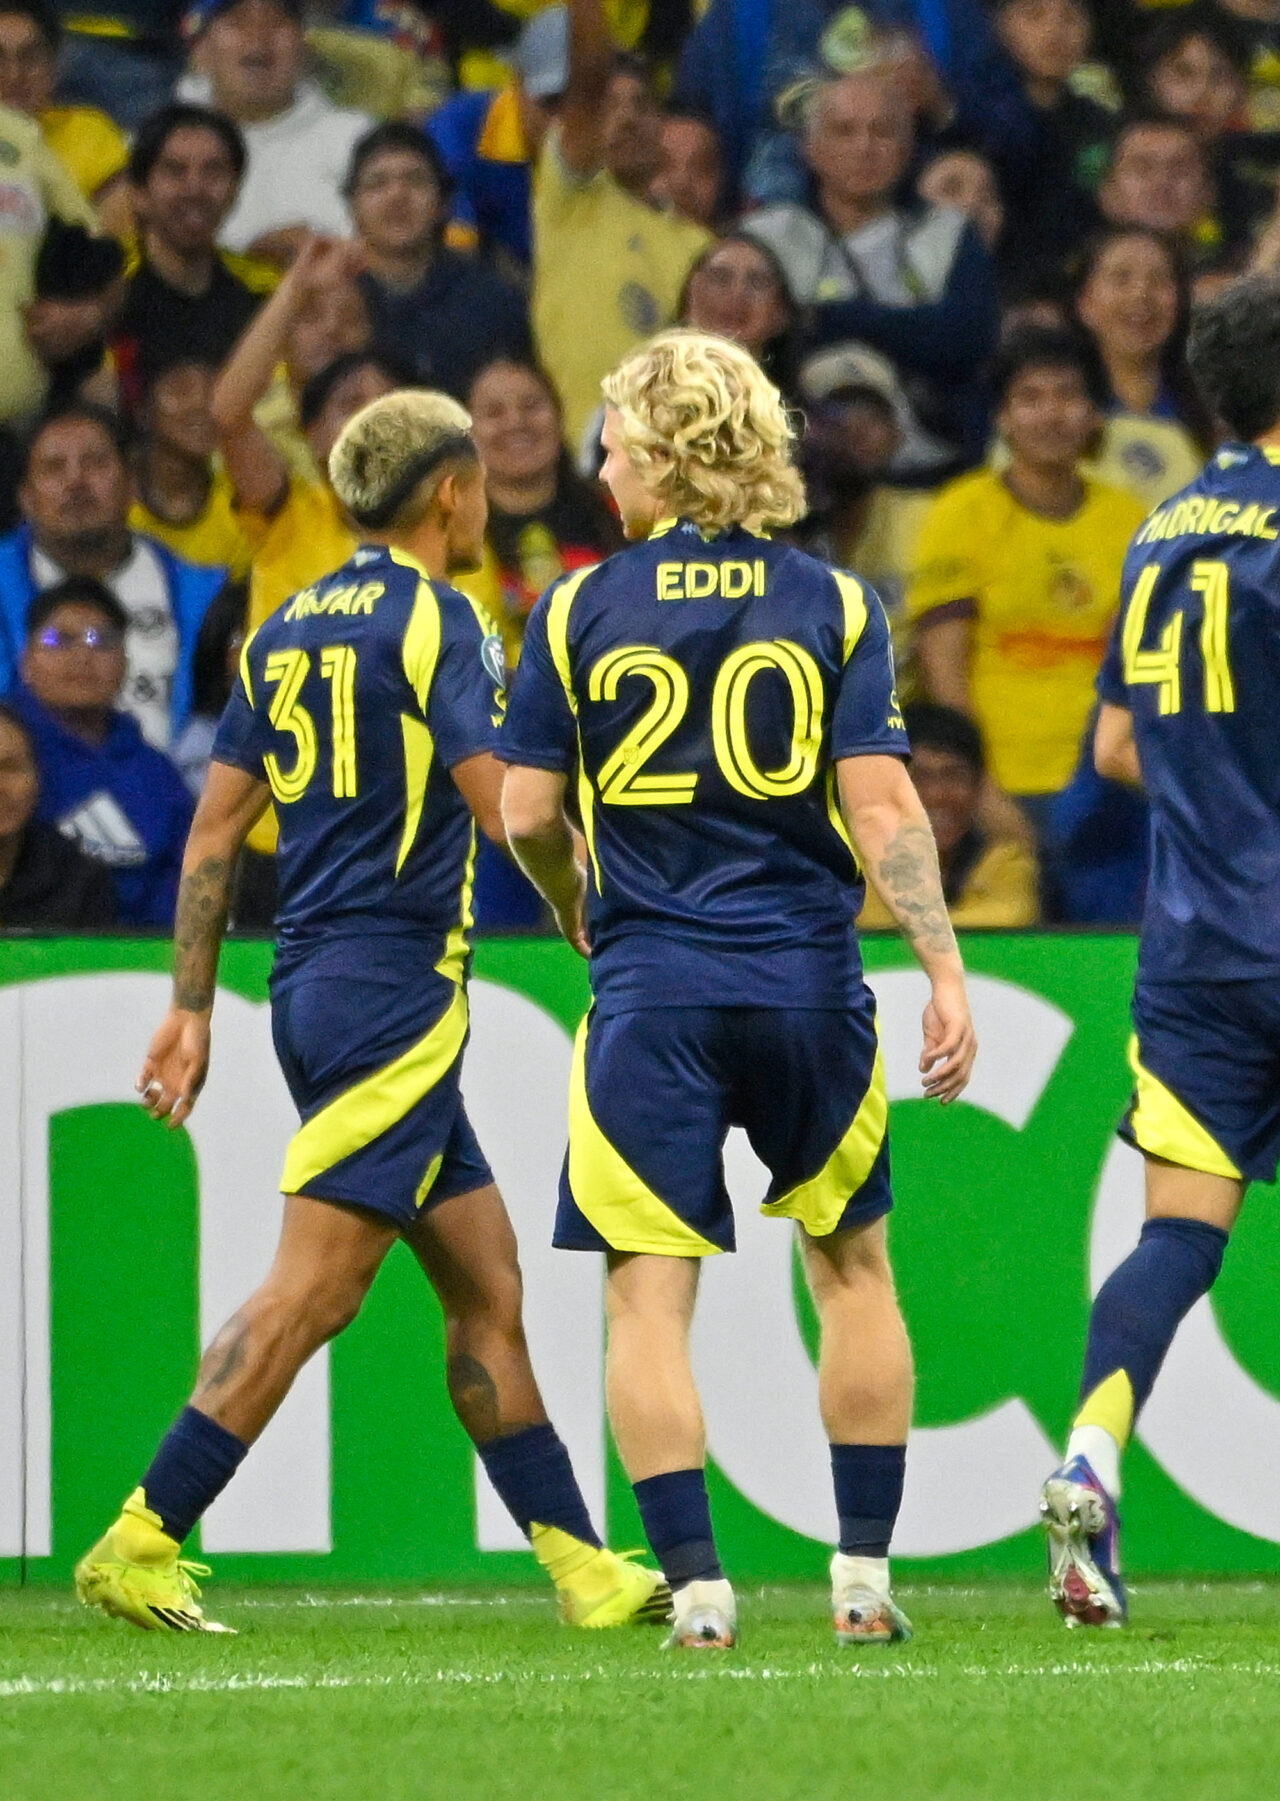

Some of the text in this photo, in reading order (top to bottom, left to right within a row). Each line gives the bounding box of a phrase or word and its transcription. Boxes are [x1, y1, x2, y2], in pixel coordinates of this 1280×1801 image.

[656, 559, 766, 601] EDDI
[1137, 495, 1280, 545] MADRIGAL
[1122, 559, 1235, 715] 41
[263, 646, 357, 803] 31
[589, 640, 824, 806] 20
